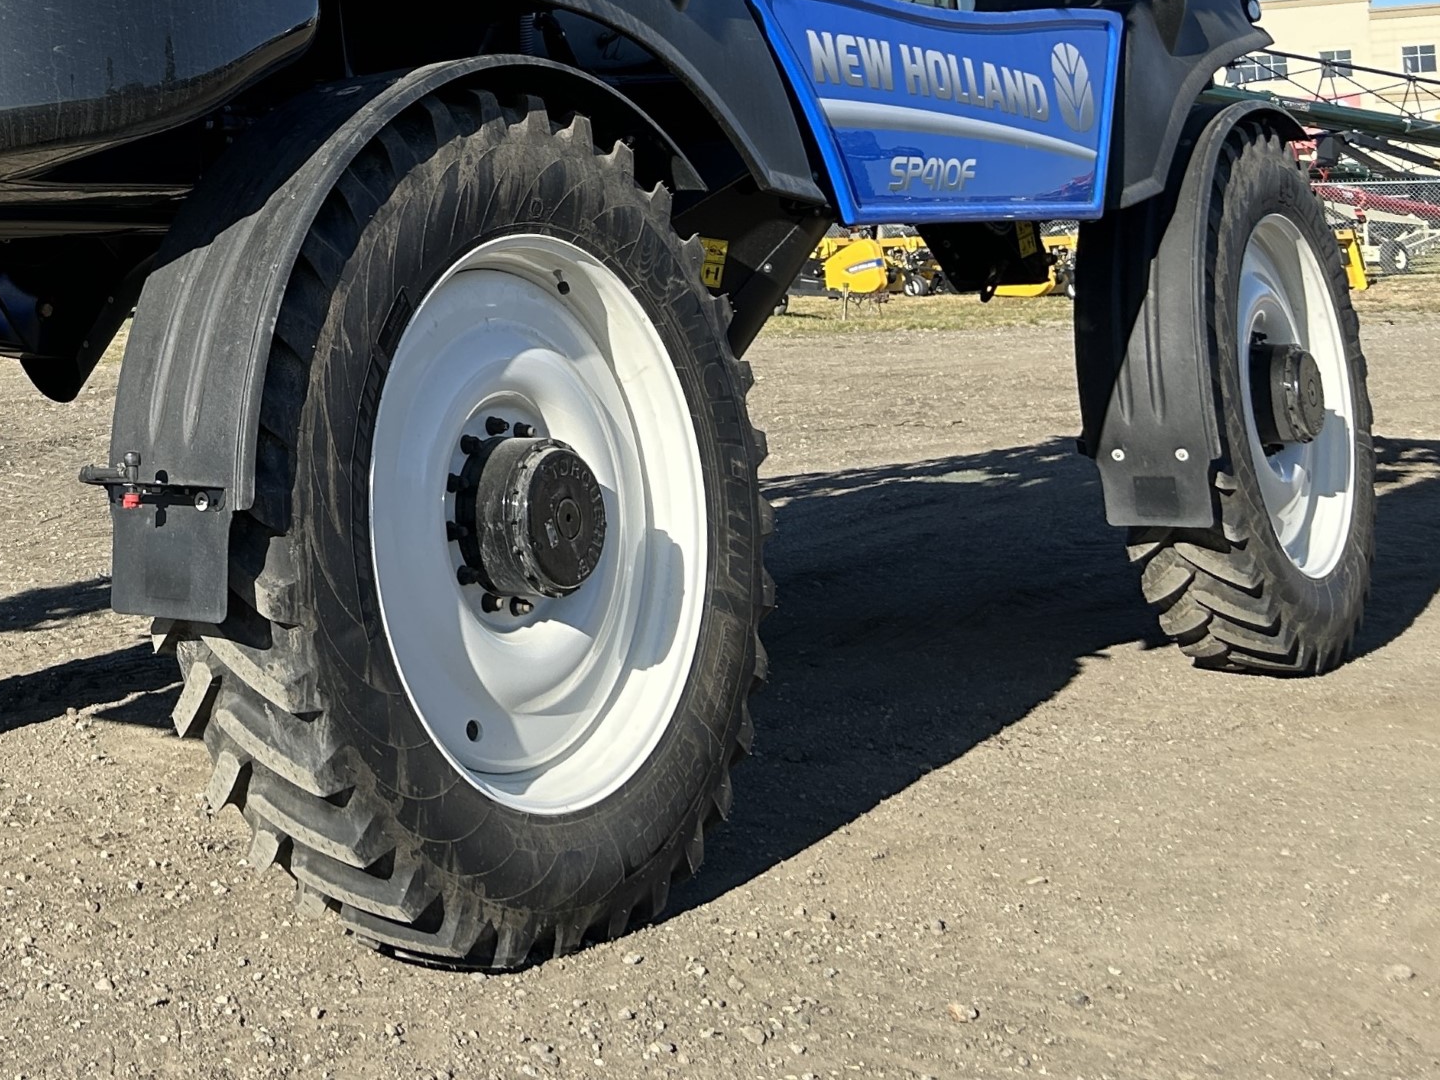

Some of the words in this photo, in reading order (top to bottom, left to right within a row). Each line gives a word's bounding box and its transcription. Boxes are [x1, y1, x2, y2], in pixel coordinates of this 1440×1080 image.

[806, 29, 894, 92] NEW
[899, 43, 1050, 122] HOLLAND
[888, 155, 977, 192] SP410F
